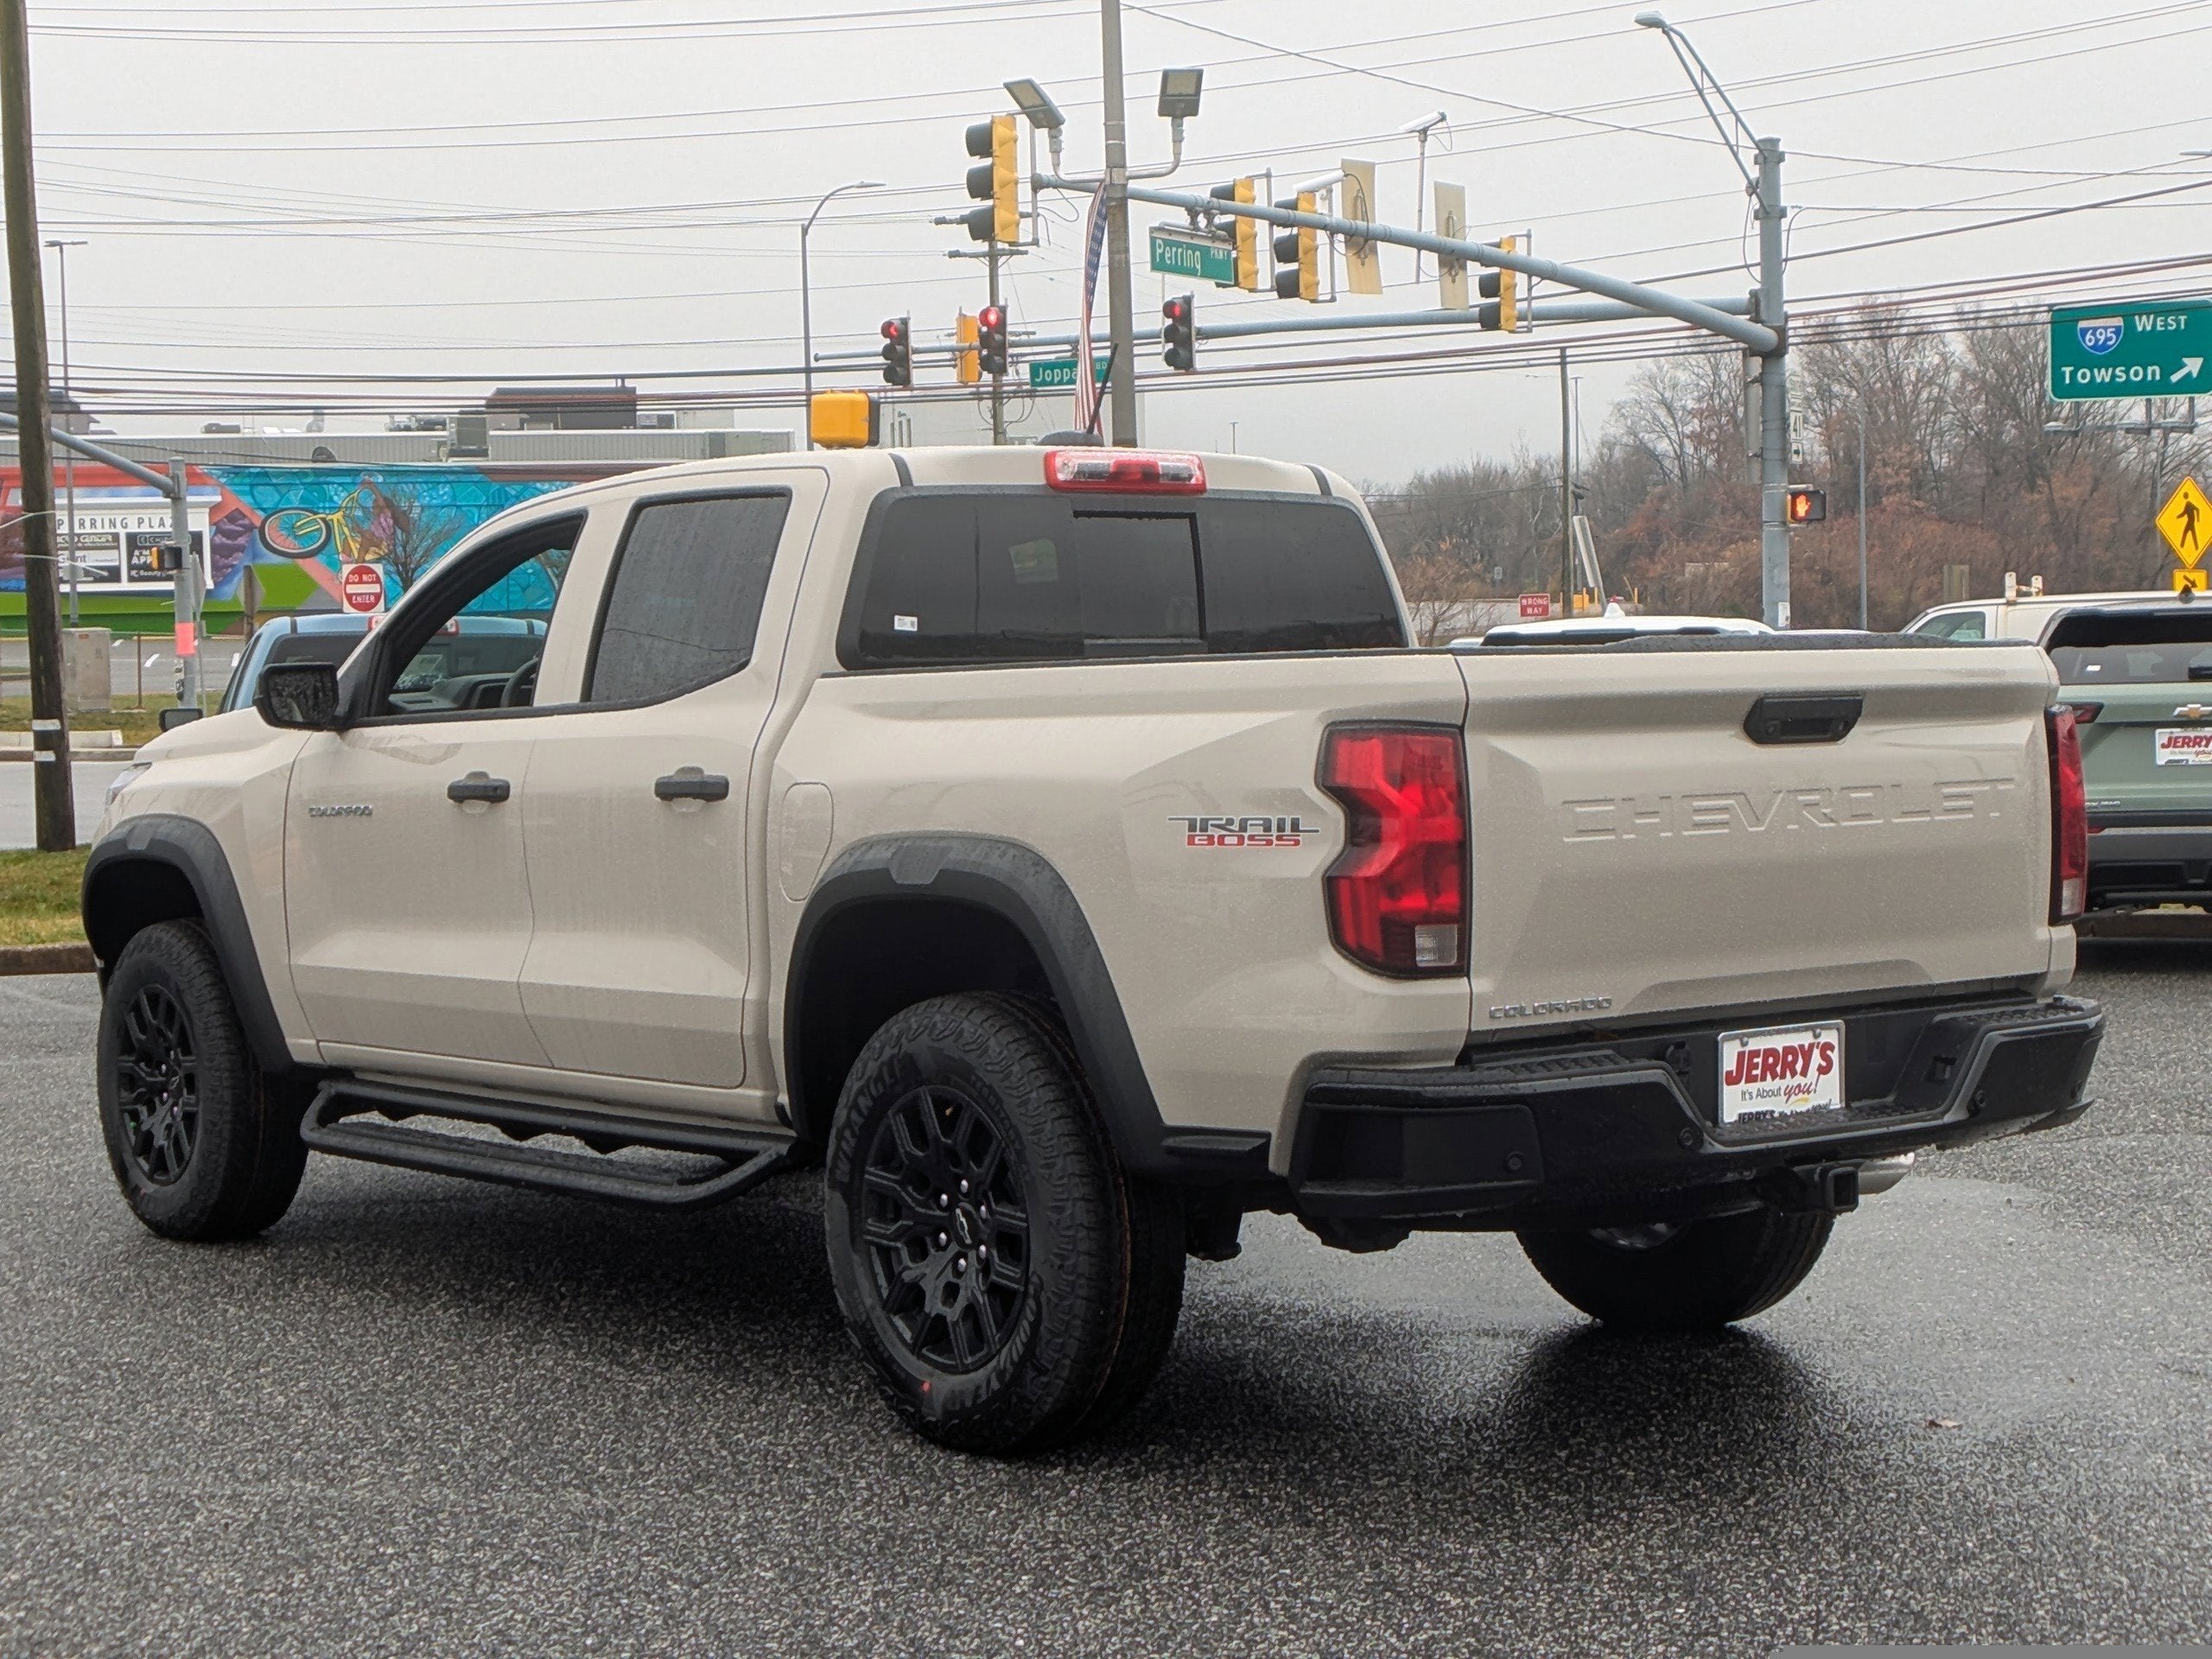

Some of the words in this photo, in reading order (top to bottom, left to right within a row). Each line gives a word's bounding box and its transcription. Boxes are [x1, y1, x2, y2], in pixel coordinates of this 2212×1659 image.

[1155, 238, 1201, 276] Perring
[2084, 327, 2118, 346] 695
[1034, 366, 1077, 385] Joppa
[1095, 361, 1107, 370] RD
[2061, 365, 2161, 385] Towson
[57, 517, 129, 530] PRRING
[137, 517, 173, 529] PLA
[348, 574, 359, 582] DO
[362, 574, 377, 582] NOT
[352, 594, 375, 604] ENTER
[1562, 778, 2014, 842] CHEVROLET
[1167, 817, 1320, 833] TRAIL
[1186, 834, 1301, 847] BOSS
[1489, 996, 1612, 1019] COLORADO
[1725, 1041, 1835, 1087] JERRY'S
[1740, 1089, 1753, 1102] It's
[1755, 1087, 1782, 1100] About
